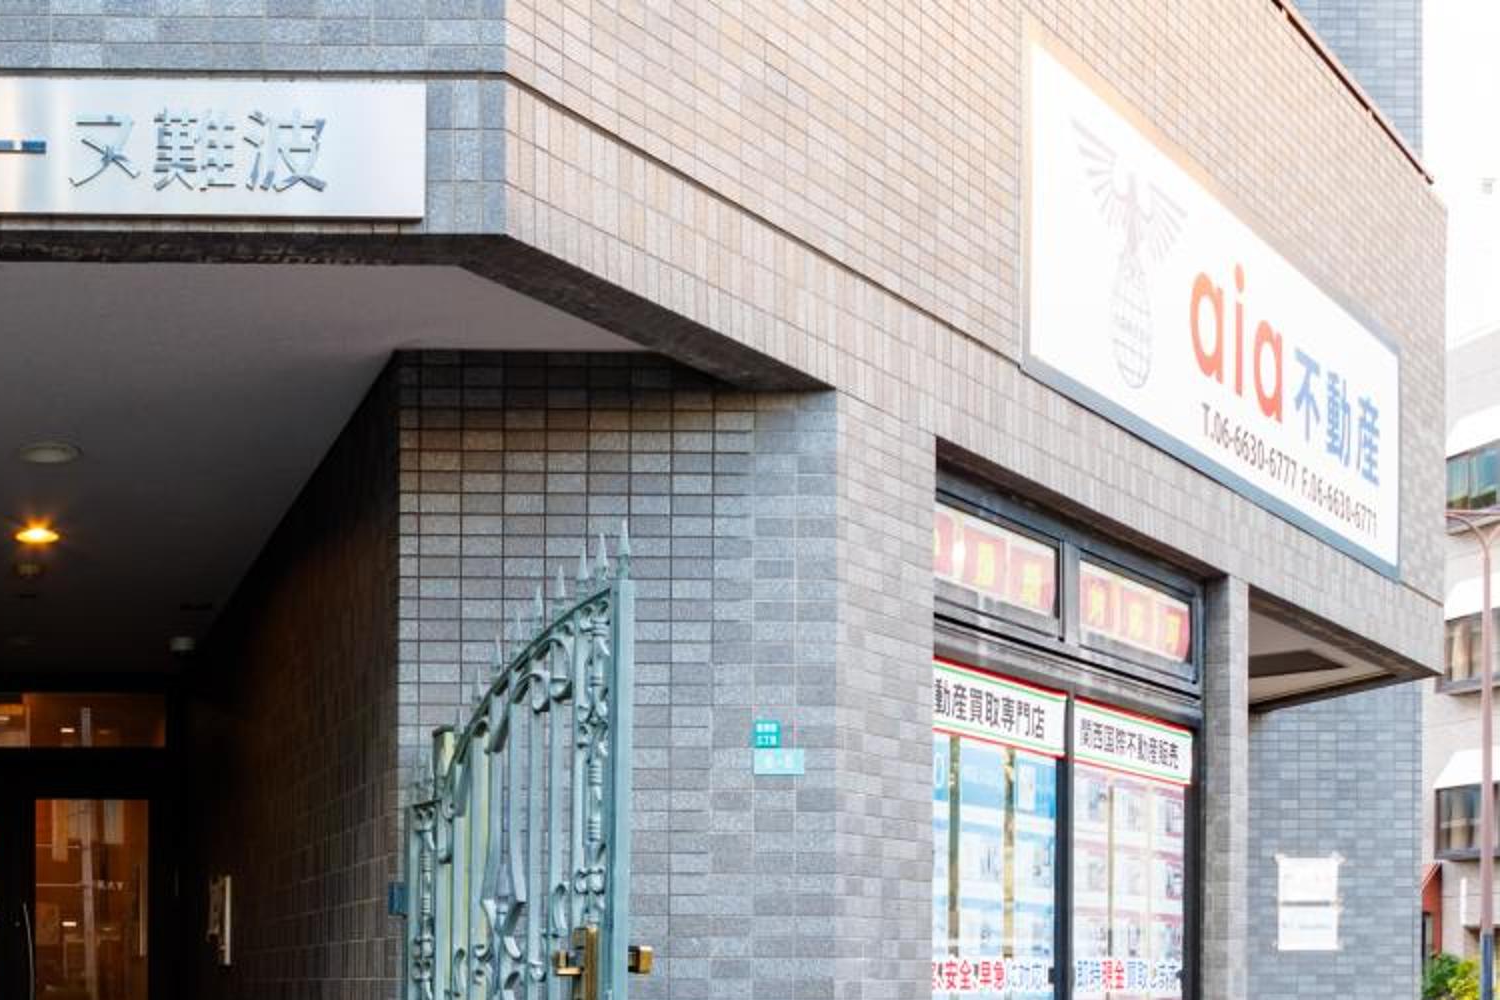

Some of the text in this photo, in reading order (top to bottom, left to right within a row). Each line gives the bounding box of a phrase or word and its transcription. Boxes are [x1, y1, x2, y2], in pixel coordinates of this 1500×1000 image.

[1190, 262, 1380, 487] aia 不動産
[1202, 402, 1297, 490] T.06-6630-6777
